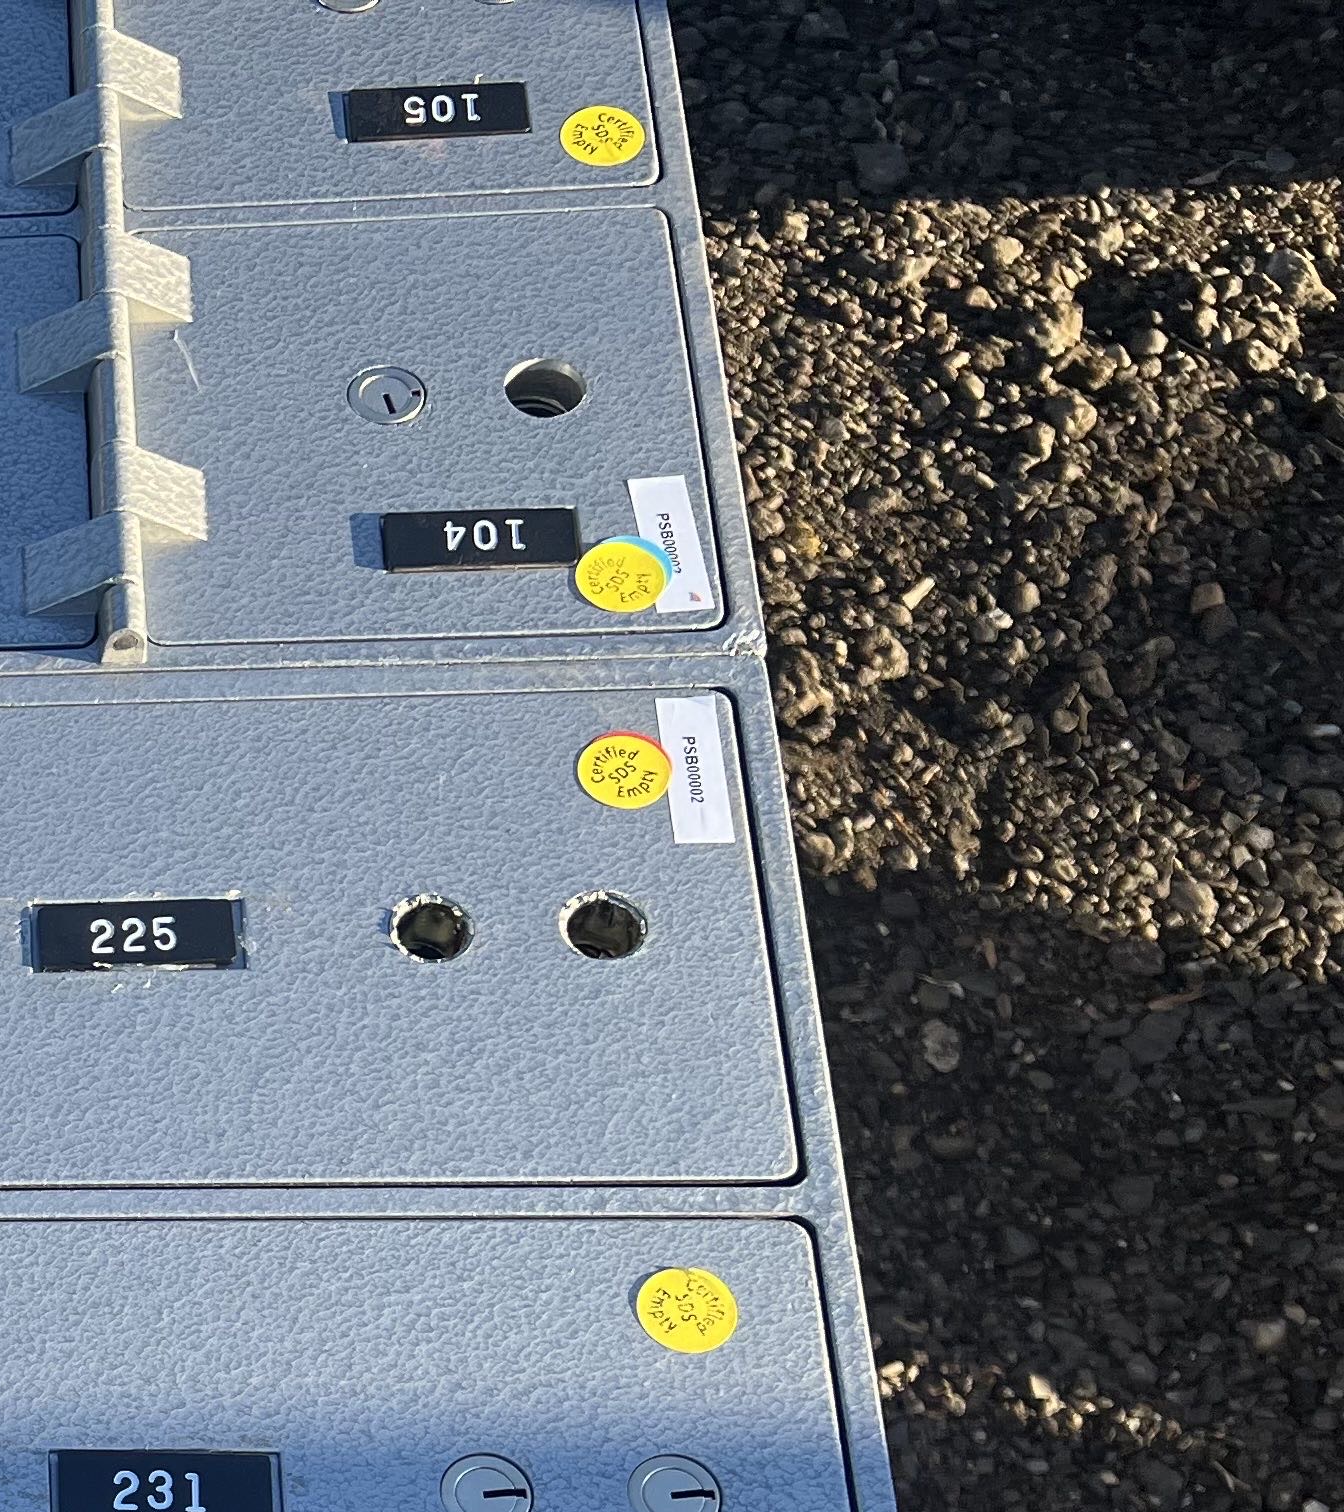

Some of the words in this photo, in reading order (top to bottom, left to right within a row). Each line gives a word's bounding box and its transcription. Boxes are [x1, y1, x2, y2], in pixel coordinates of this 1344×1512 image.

[403, 93, 481, 124] 105
[443, 519, 527, 551] 104
[605, 568, 629, 592] SDS
[591, 746, 640, 783] Certified
[608, 761, 636, 784] SDS
[682, 736, 705, 803] PSB00002
[617, 770, 658, 798] Empty
[89, 916, 177, 953] 225
[647, 1288, 677, 1333] Empty
[675, 1294, 697, 1321] SDS
[686, 1278, 725, 1336] Certified
[112, 1470, 206, 1512] 231
